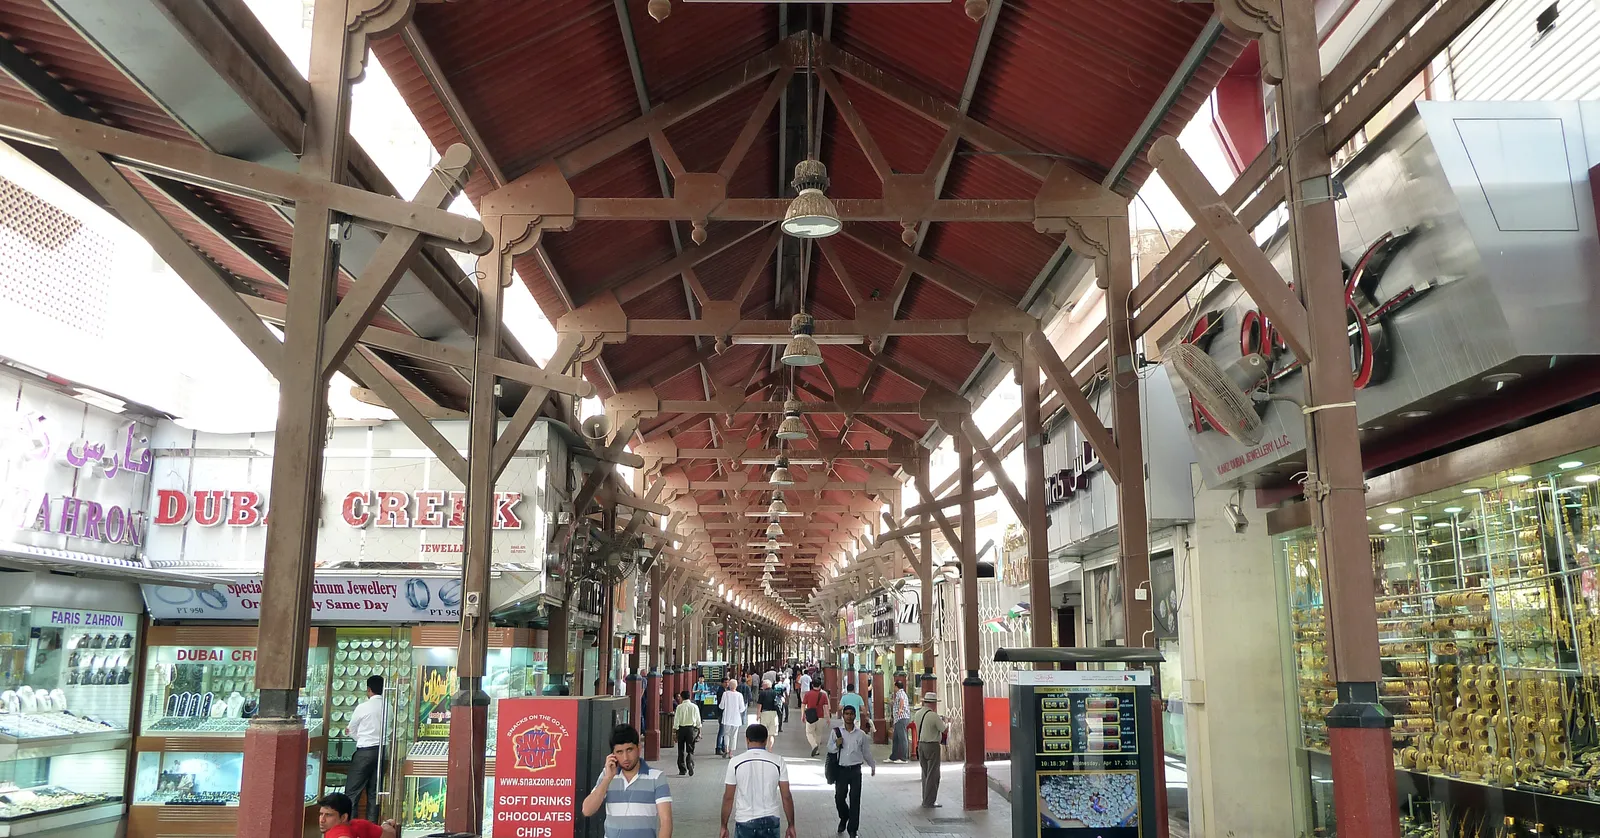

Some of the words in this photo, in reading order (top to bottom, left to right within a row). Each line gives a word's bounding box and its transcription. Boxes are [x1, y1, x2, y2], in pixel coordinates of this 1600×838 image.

[1245, 441, 1274, 463] JEWELLERY
[17, 490, 143, 546] AHRON
[347, 580, 398, 599] Jewellery
[326, 599, 361, 610] Same
[364, 599, 389, 613] Day
[51, 610, 81, 625] FARIS
[85, 613, 124, 627] ZAHRON
[177, 649, 224, 661] DUBAI
[507, 717, 528, 737] SNACKS
[551, 718, 561, 726] GO
[500, 777, 572, 786] www.snaxzone.com
[499, 796, 528, 806] SOFT
[530, 796, 572, 806] DRINKS
[497, 811, 572, 822] CHOCOLATES
[516, 827, 552, 838] CHIPS
